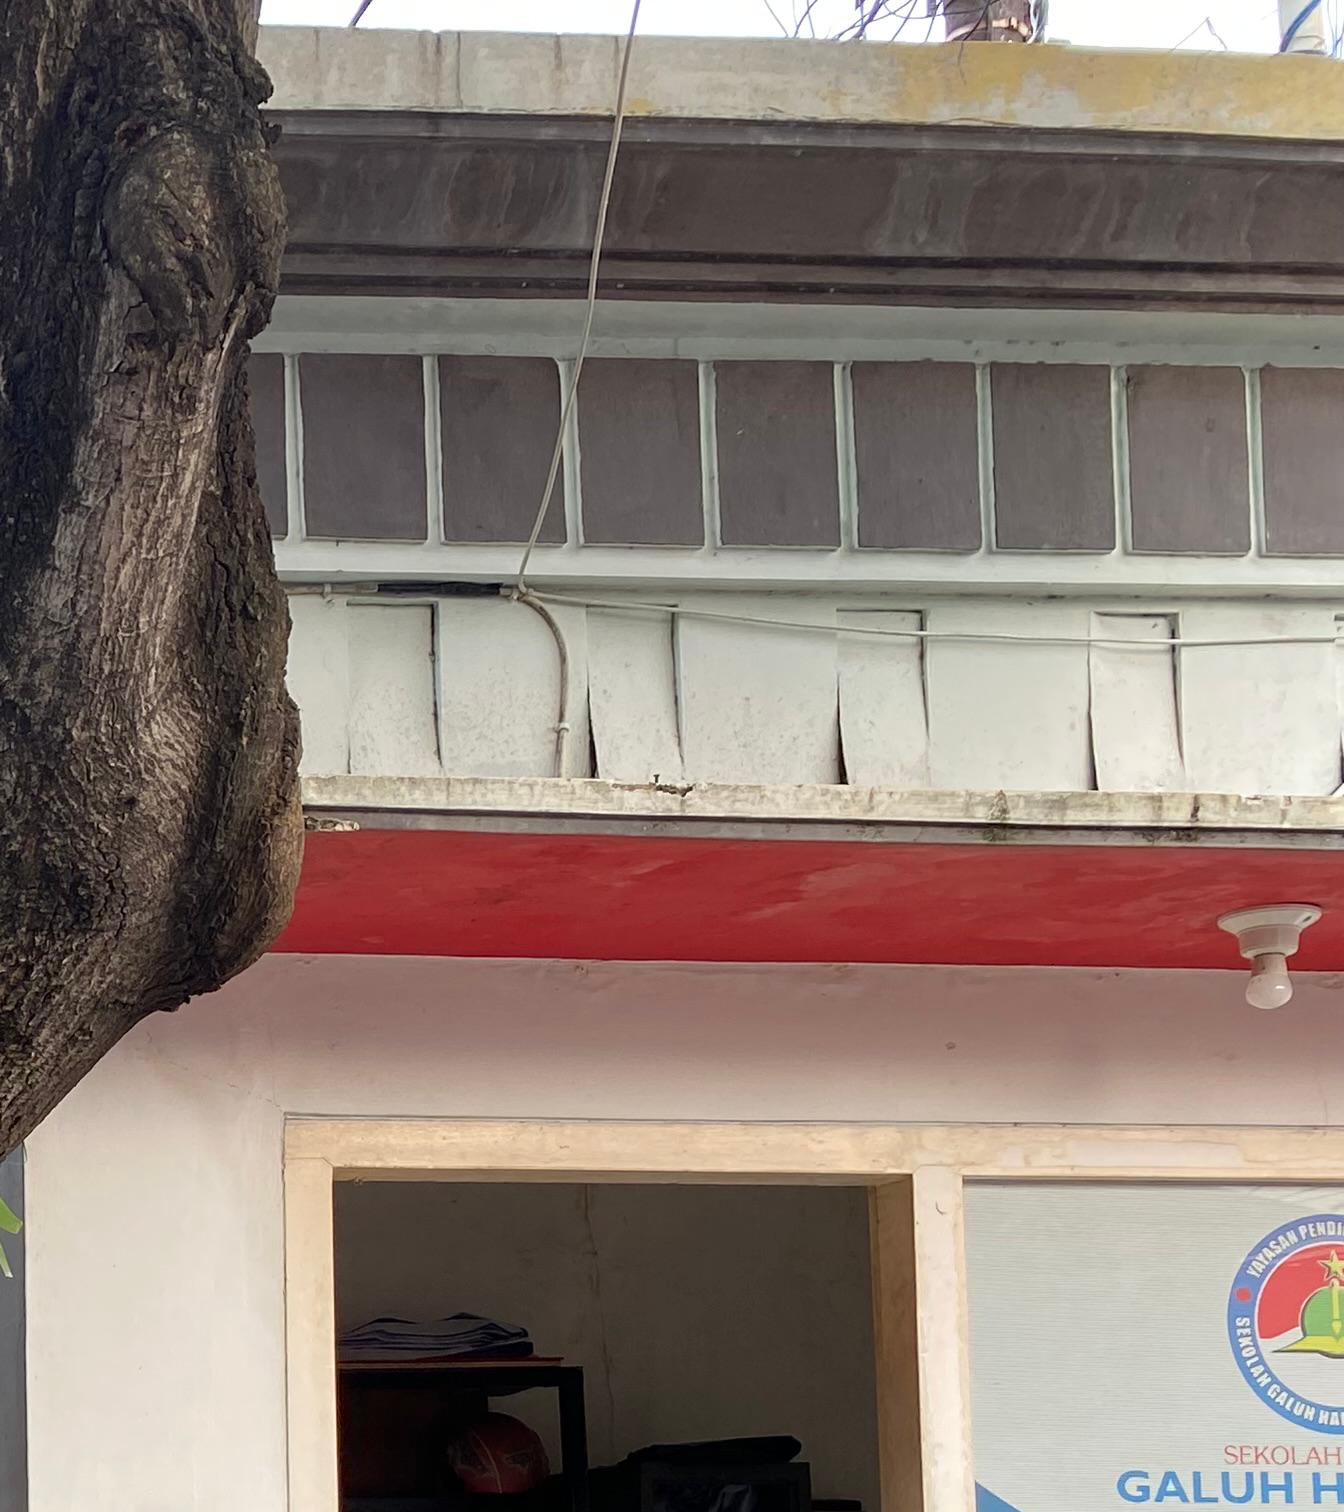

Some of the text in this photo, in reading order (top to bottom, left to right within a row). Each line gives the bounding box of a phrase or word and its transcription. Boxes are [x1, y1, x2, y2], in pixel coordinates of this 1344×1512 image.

[1246, 1229, 1299, 1279] YAYASAN
[1236, 1316, 1272, 1388] SEKOLAH
[1267, 1381, 1316, 1422] GALUH
[1224, 1445, 1342, 1466] SEKOLAH
[1116, 1470, 1294, 1504] GALUH
